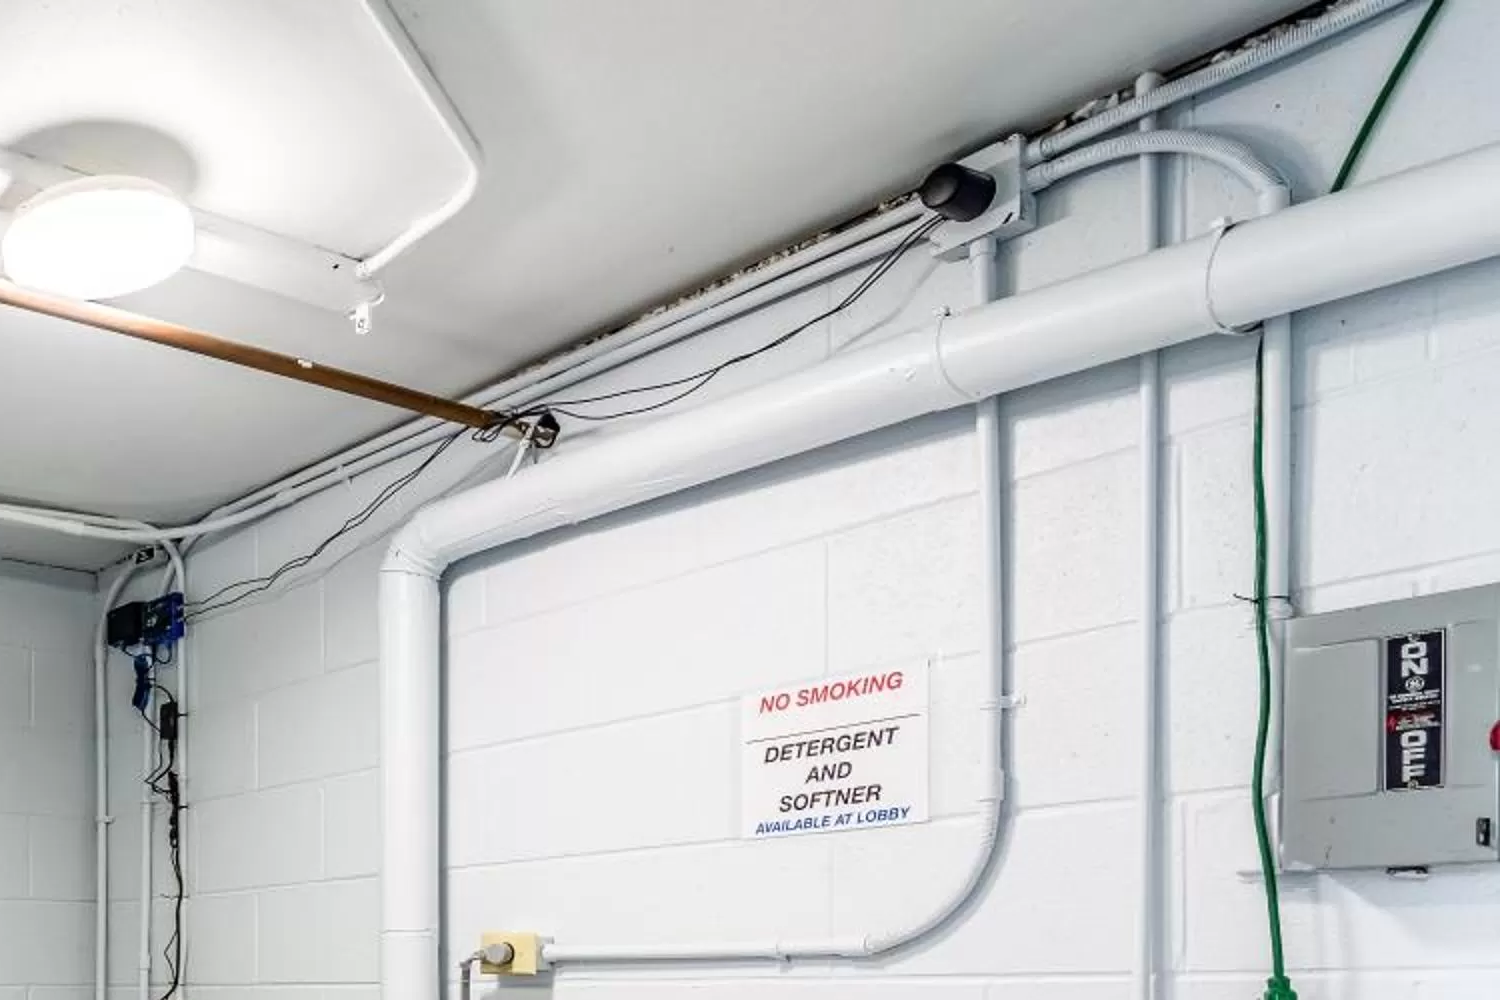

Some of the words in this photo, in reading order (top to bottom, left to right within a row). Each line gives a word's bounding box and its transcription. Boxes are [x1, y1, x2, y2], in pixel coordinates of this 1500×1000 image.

[1401, 641, 1428, 678] ON
[759, 693, 790, 714] NO
[796, 671, 904, 707] SMOKING
[764, 726, 900, 763] DETERGENT
[1400, 730, 1427, 783] OFF
[805, 761, 852, 784] AND
[779, 784, 882, 813] SOFTNER
[756, 815, 831, 834] AVAILABLE
[835, 813, 852, 825] AT
[857, 806, 911, 824] LOBBY
